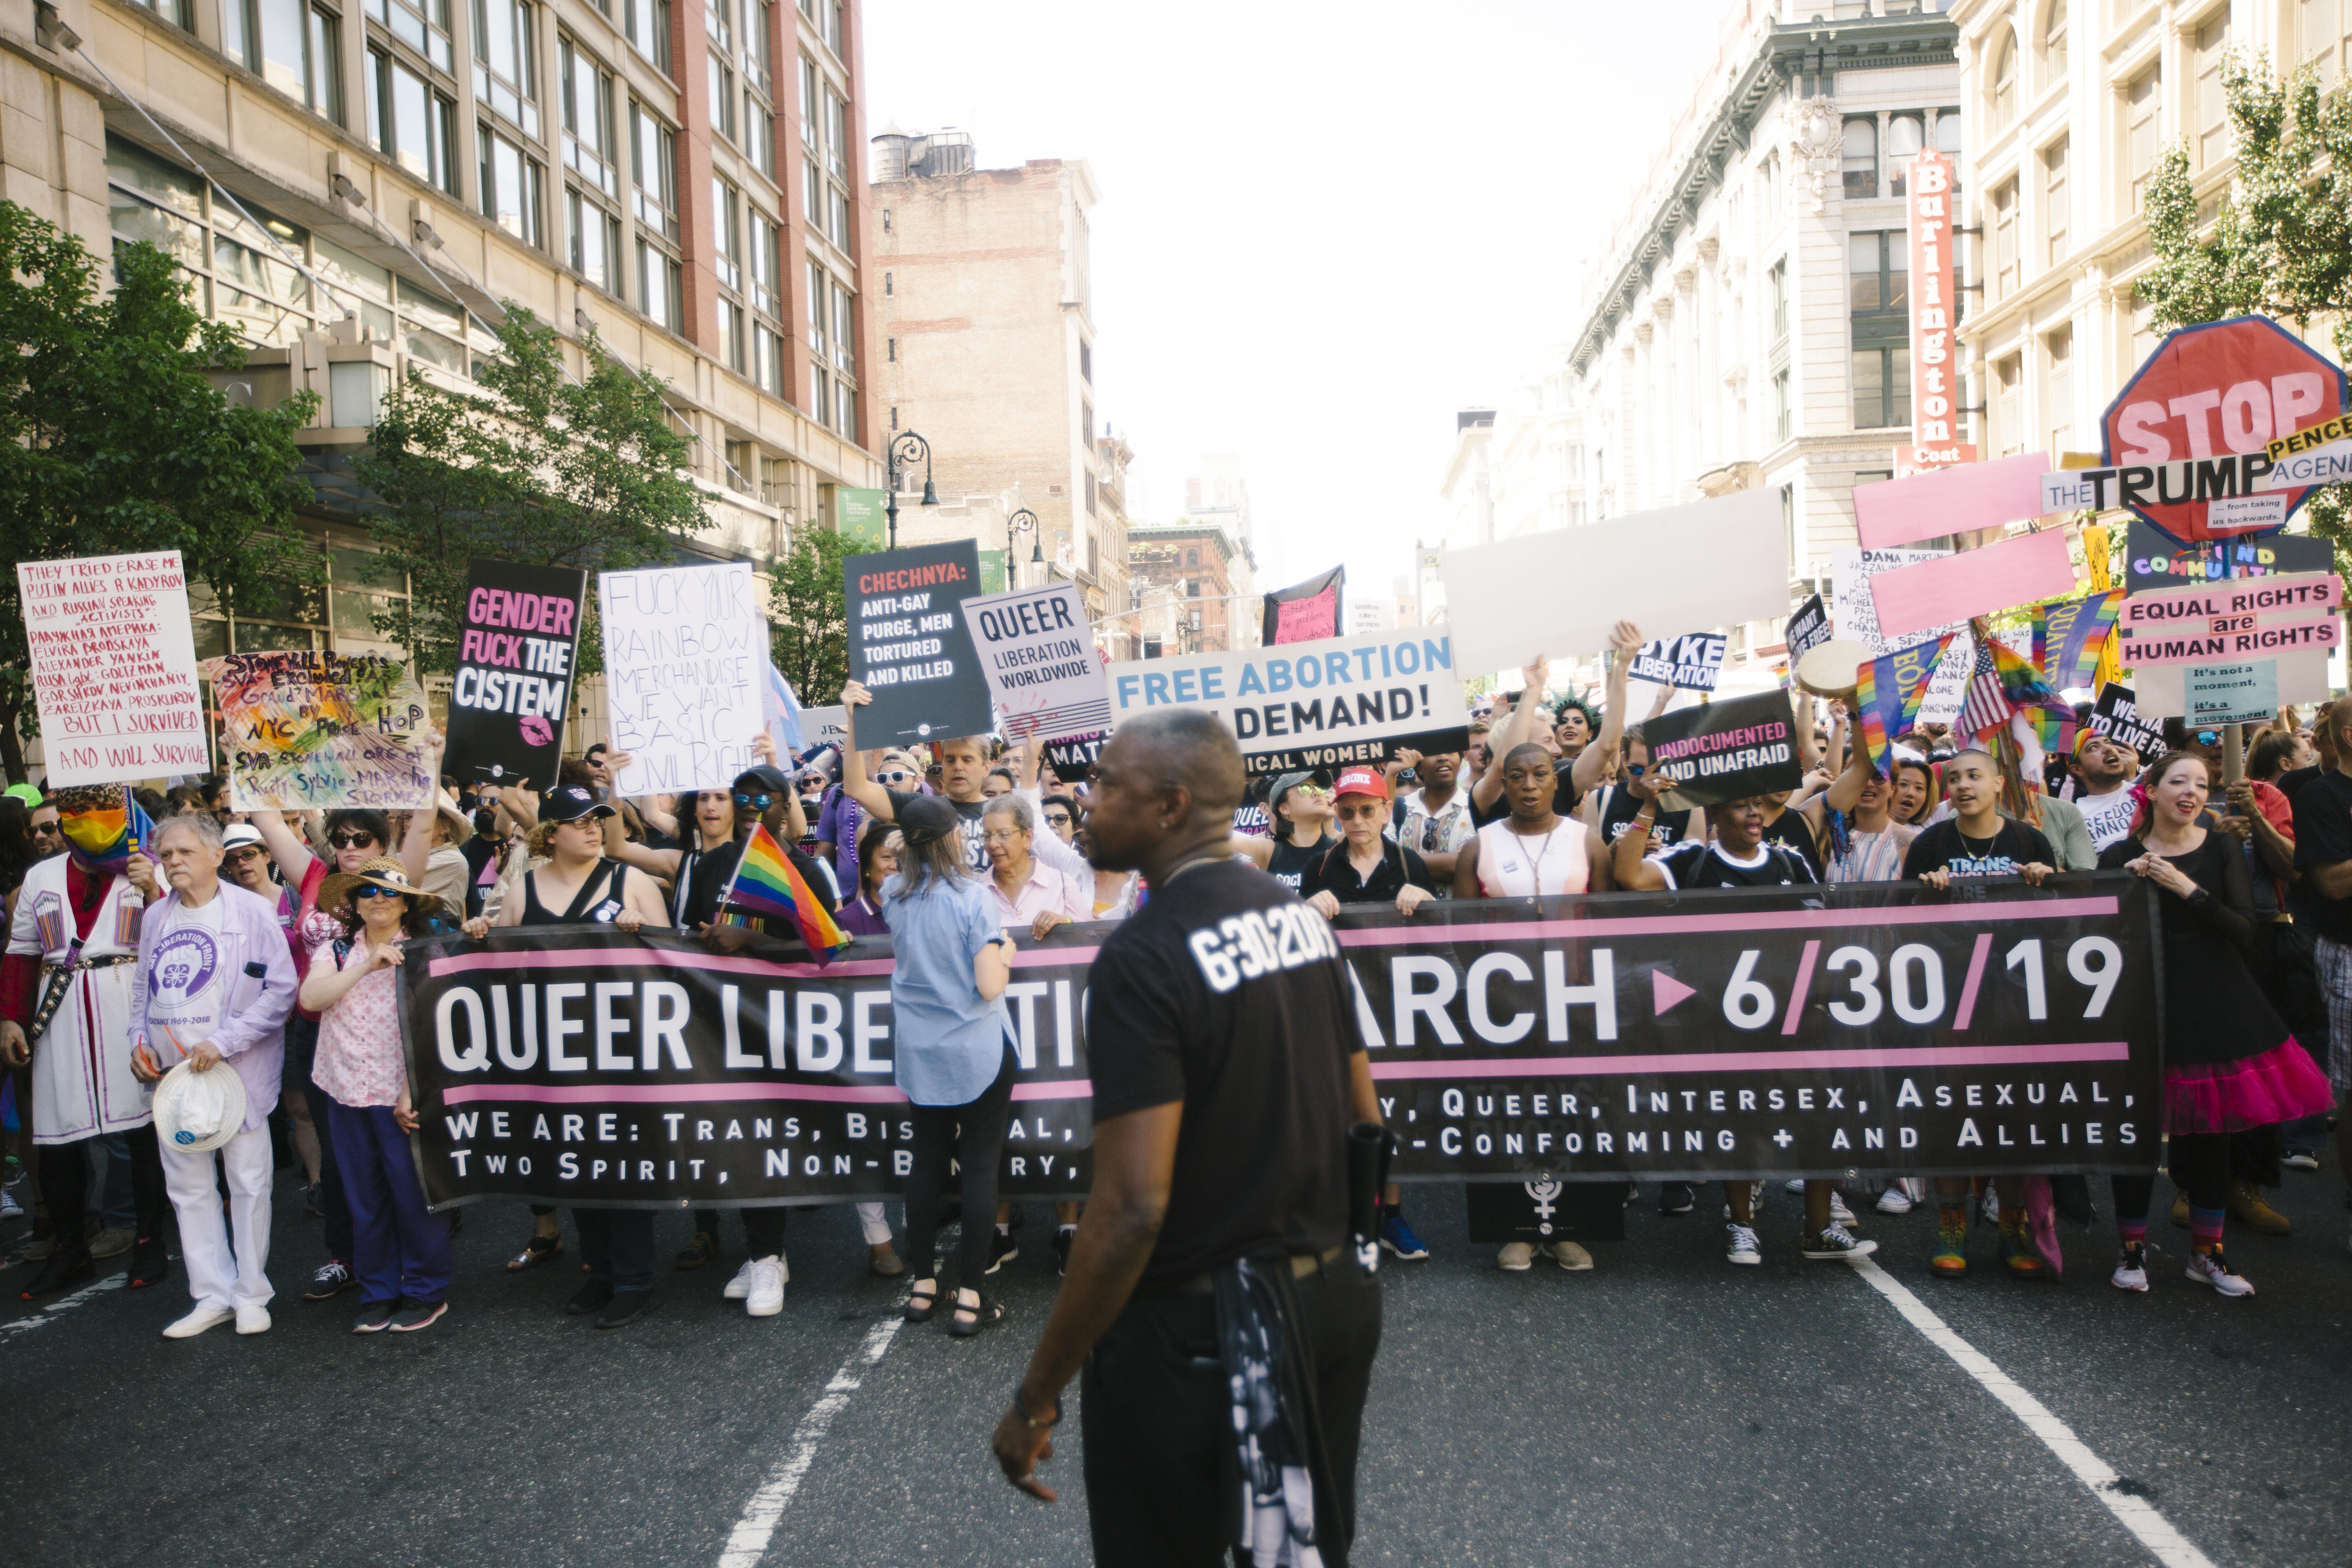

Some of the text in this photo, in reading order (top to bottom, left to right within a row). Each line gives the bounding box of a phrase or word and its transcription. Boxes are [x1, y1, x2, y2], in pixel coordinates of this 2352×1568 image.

[1916, 165, 1950, 442] Burlington
[2117, 372, 2323, 466] STOP
[2270, 414, 2352, 461] PENCE
[1914, 448, 1960, 463] Coat
[2049, 452, 2352, 511] THE TRUMP AGEN
[2227, 502, 2248, 510] from
[2250, 499, 2280, 511] taking
[2227, 514, 2281, 524] backwards.
[24, 566, 62, 581] THEY
[117, 558, 158, 574] ERASE
[162, 557, 182, 568] ME
[1862, 551, 1901, 563] DANA
[860, 562, 967, 594] CHECHNYA:
[32, 604, 57, 617] AND
[468, 586, 575, 636] GENDER
[608, 569, 750, 621] FUCK YOUR
[861, 593, 930, 617] ANTI-GAY
[1278, 599, 1314, 618] Prostitution
[1840, 594, 1873, 607] MICHEL
[2129, 584, 2329, 621] EQUAL RIGHTS
[863, 613, 952, 640] PURGE, MEN
[980, 597, 1075, 642] QUEER
[1282, 620, 1291, 630] the
[1794, 608, 1818, 640] WANT
[2214, 615, 2254, 633] are
[461, 628, 571, 675] FUCK THE
[612, 622, 750, 663] RAINBOW
[864, 639, 941, 663] TORTURED
[993, 638, 1082, 670] LIBERATION
[2125, 638, 2225, 661] HUMAN
[2236, 624, 2334, 652] RIGHTS
[38, 655, 104, 674] ALEXANDER
[615, 656, 751, 698] MERCHANDISE
[866, 661, 953, 687] AND KILLED
[1000, 660, 1090, 690] WORLDWIDE
[1117, 635, 1451, 708] FREE ABORTION
[1629, 656, 1719, 688] LIBERATION
[2193, 668, 2209, 677] It's
[2216, 666, 2243, 676] not
[455, 666, 566, 721] CISTEM
[2194, 681, 2257, 691] moment,
[299, 705, 321, 724] BY
[611, 684, 751, 722] WE WANT
[1234, 684, 1431, 739] DEMAND!
[2112, 698, 2136, 723] WE
[2194, 700, 2217, 709] it's
[2194, 710, 2268, 723] movement
[63, 714, 102, 734] BUT
[113, 713, 121, 734] I
[247, 705, 424, 739] NYC HOP
[617, 708, 735, 751] BASIC
[2089, 713, 2151, 751] TO LIVE
[1050, 739, 1111, 765] MAT
[1655, 722, 1786, 760] UNDOCUMENTED
[60, 746, 99, 770] AND
[618, 741, 765, 793] CIVIL RIGHT
[1243, 742, 1384, 773] ICAL WOMEN
[1659, 743, 1790, 782] AND UNAFRAID
[1338, 773, 1371, 786] BRONX
[1949, 856, 2012, 872] TRANS
[149, 933, 214, 973] GAY LIBERATION FRONT
[436, 982, 693, 1072] QUEER
[722, 980, 1089, 1072] LIBETI
[1722, 933, 2122, 1035] 6/30/19
[171, 1016, 211, 1025] 1969-2018
[445, 1111, 511, 1140] WE
[534, 1113, 638, 1141] ARE:
[664, 1113, 820, 1143] TRANS,
[1443, 1087, 1601, 1122] QUEER,
[1627, 1084, 1867, 1114] INTERSEX,
[1896, 1078, 2134, 1107] ASEXUAL,
[450, 1149, 532, 1177] TWO
[559, 1152, 728, 1185] SPIRIT,
[1831, 1127, 1918, 1149] AND
[1957, 1118, 2137, 1146] ALLIES
